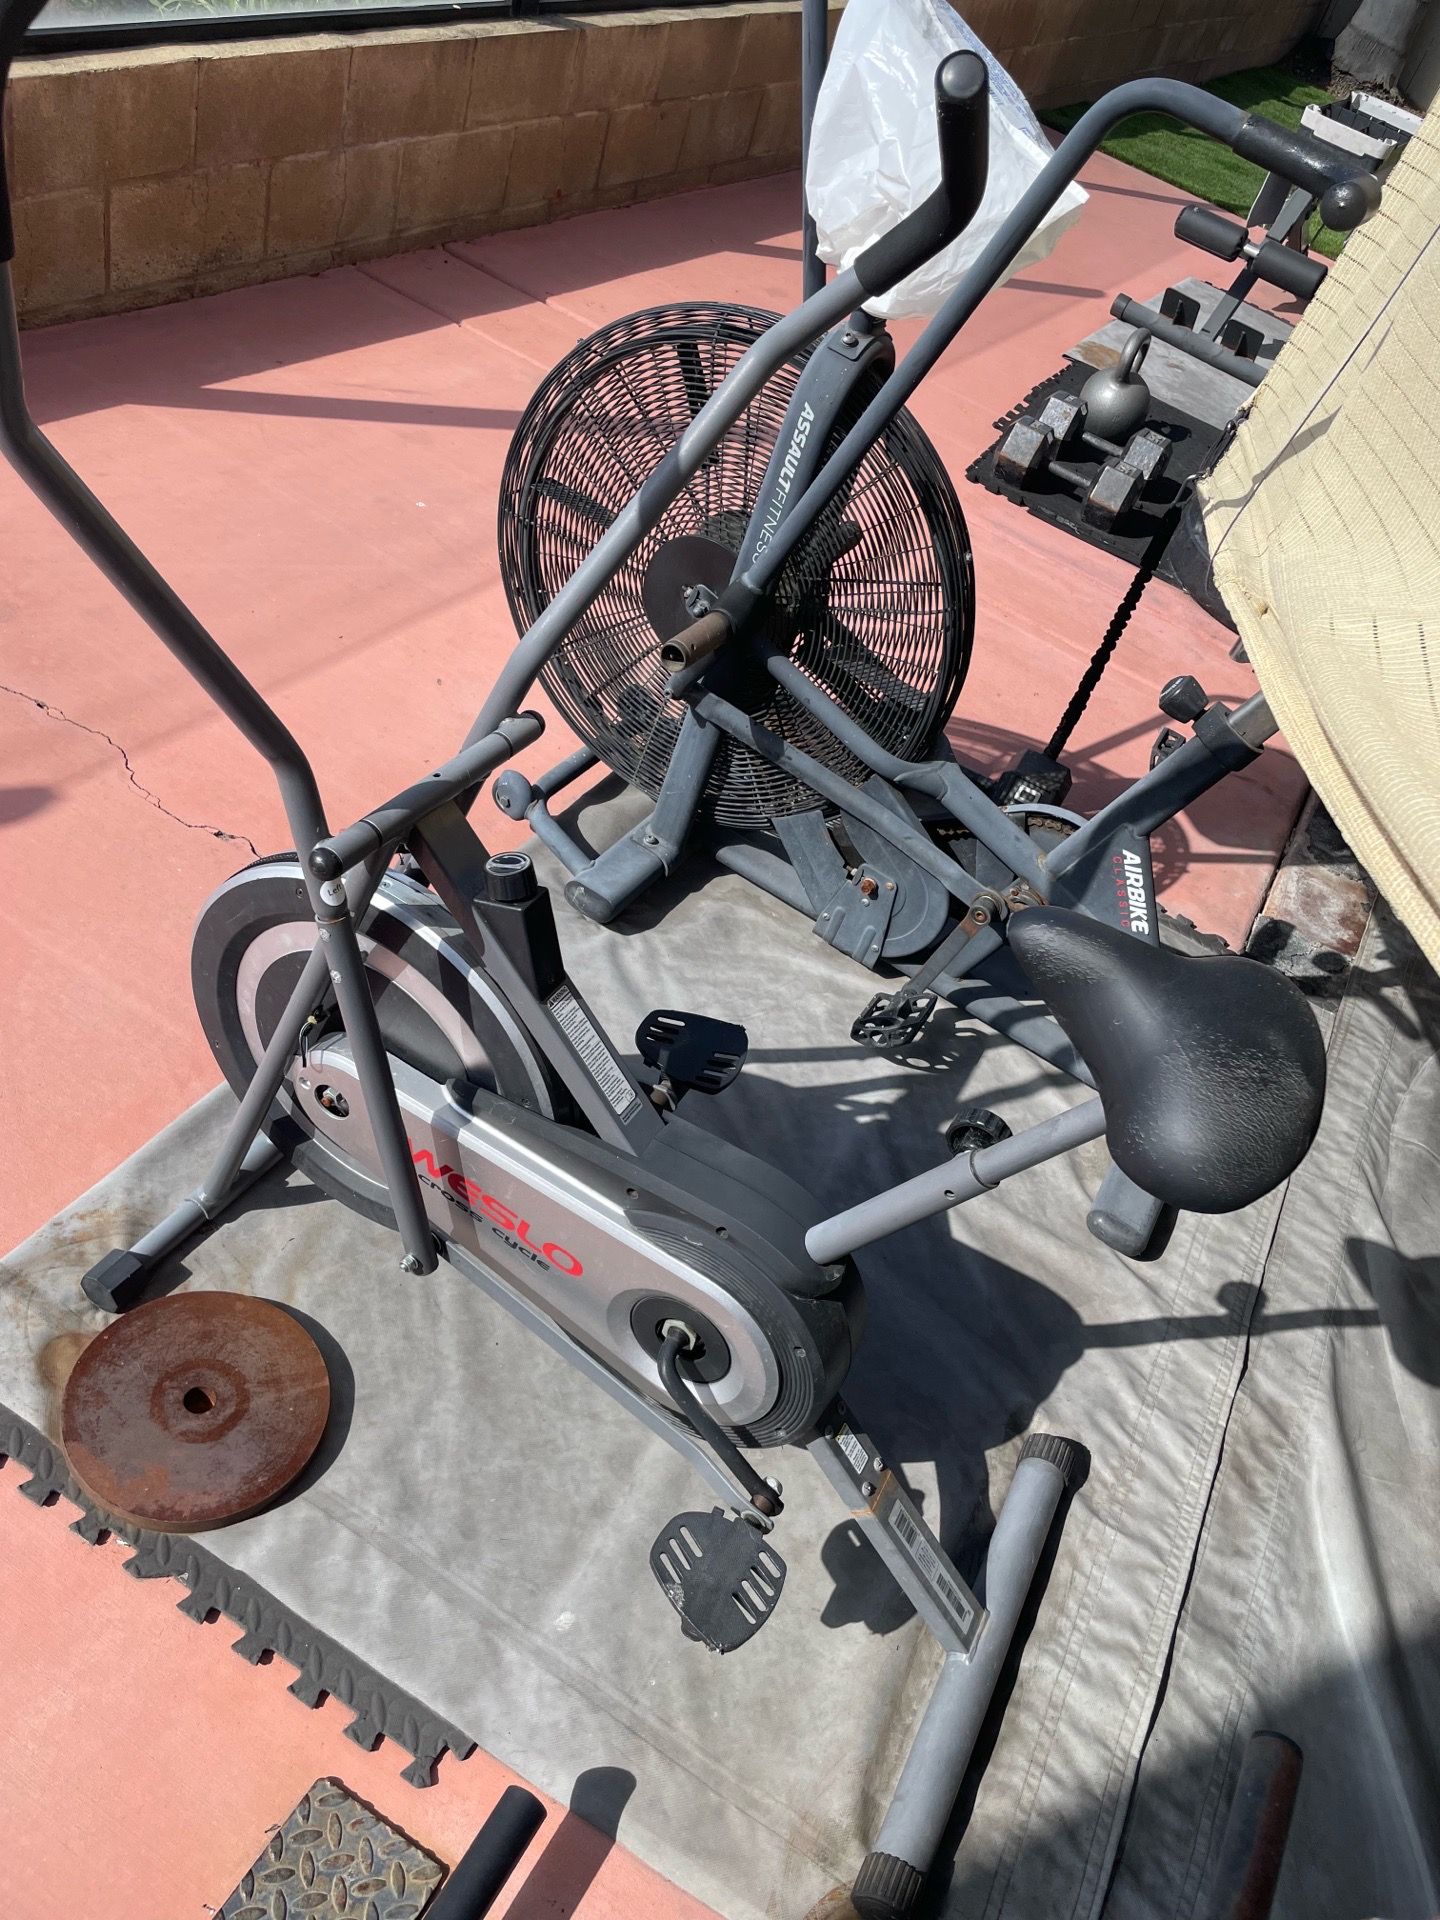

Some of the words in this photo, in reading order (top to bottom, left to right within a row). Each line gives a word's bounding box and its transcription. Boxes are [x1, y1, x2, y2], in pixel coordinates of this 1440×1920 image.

[778, 401, 815, 493] ASSAULT
[327, 883, 342, 896] Left
[1112, 855, 1130, 929] CLASSIC
[1122, 848, 1150, 935] AIRBIKE
[407, 1136, 584, 1279] WESLO
[418, 1174, 484, 1223] cross
[491, 1227, 551, 1272] cycle
